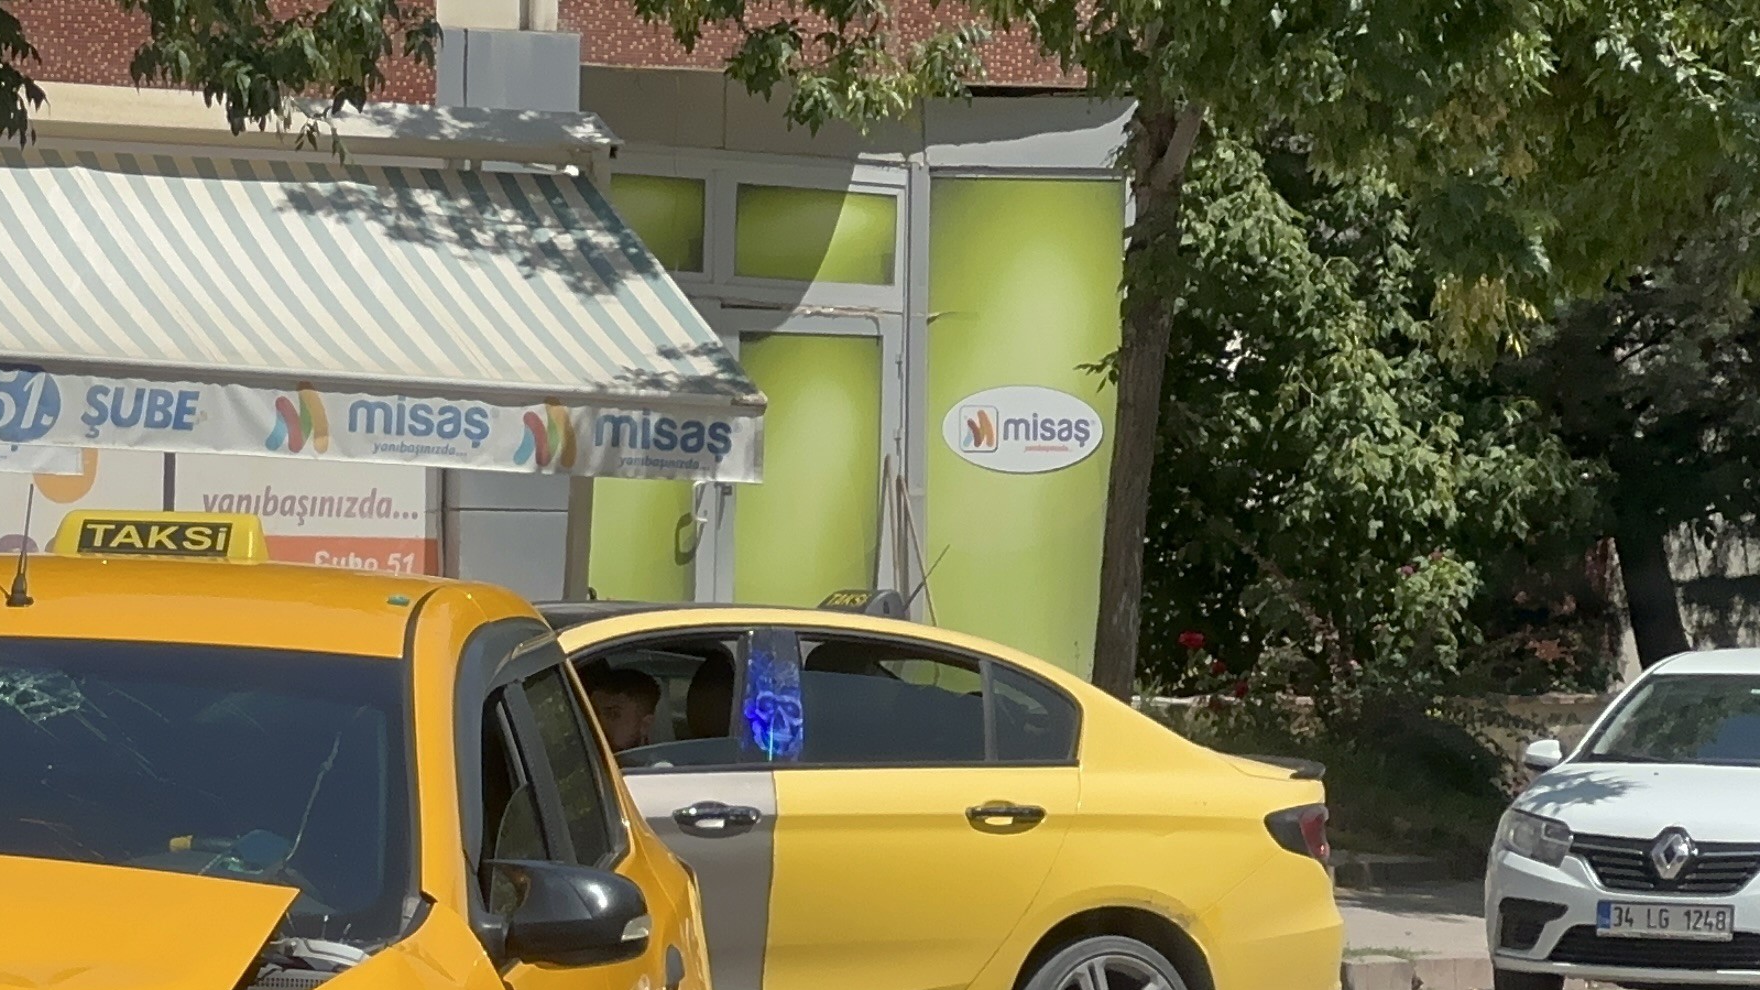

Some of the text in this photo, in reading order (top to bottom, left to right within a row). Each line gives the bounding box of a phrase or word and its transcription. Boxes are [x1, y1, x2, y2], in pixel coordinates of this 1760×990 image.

[81, 384, 200, 438] ŞUBE
[348, 395, 490, 448] misaş
[595, 407, 733, 463] misaş
[1003, 413, 1090, 447] misaş
[1613, 907, 1727, 931] 34 LG 1248
